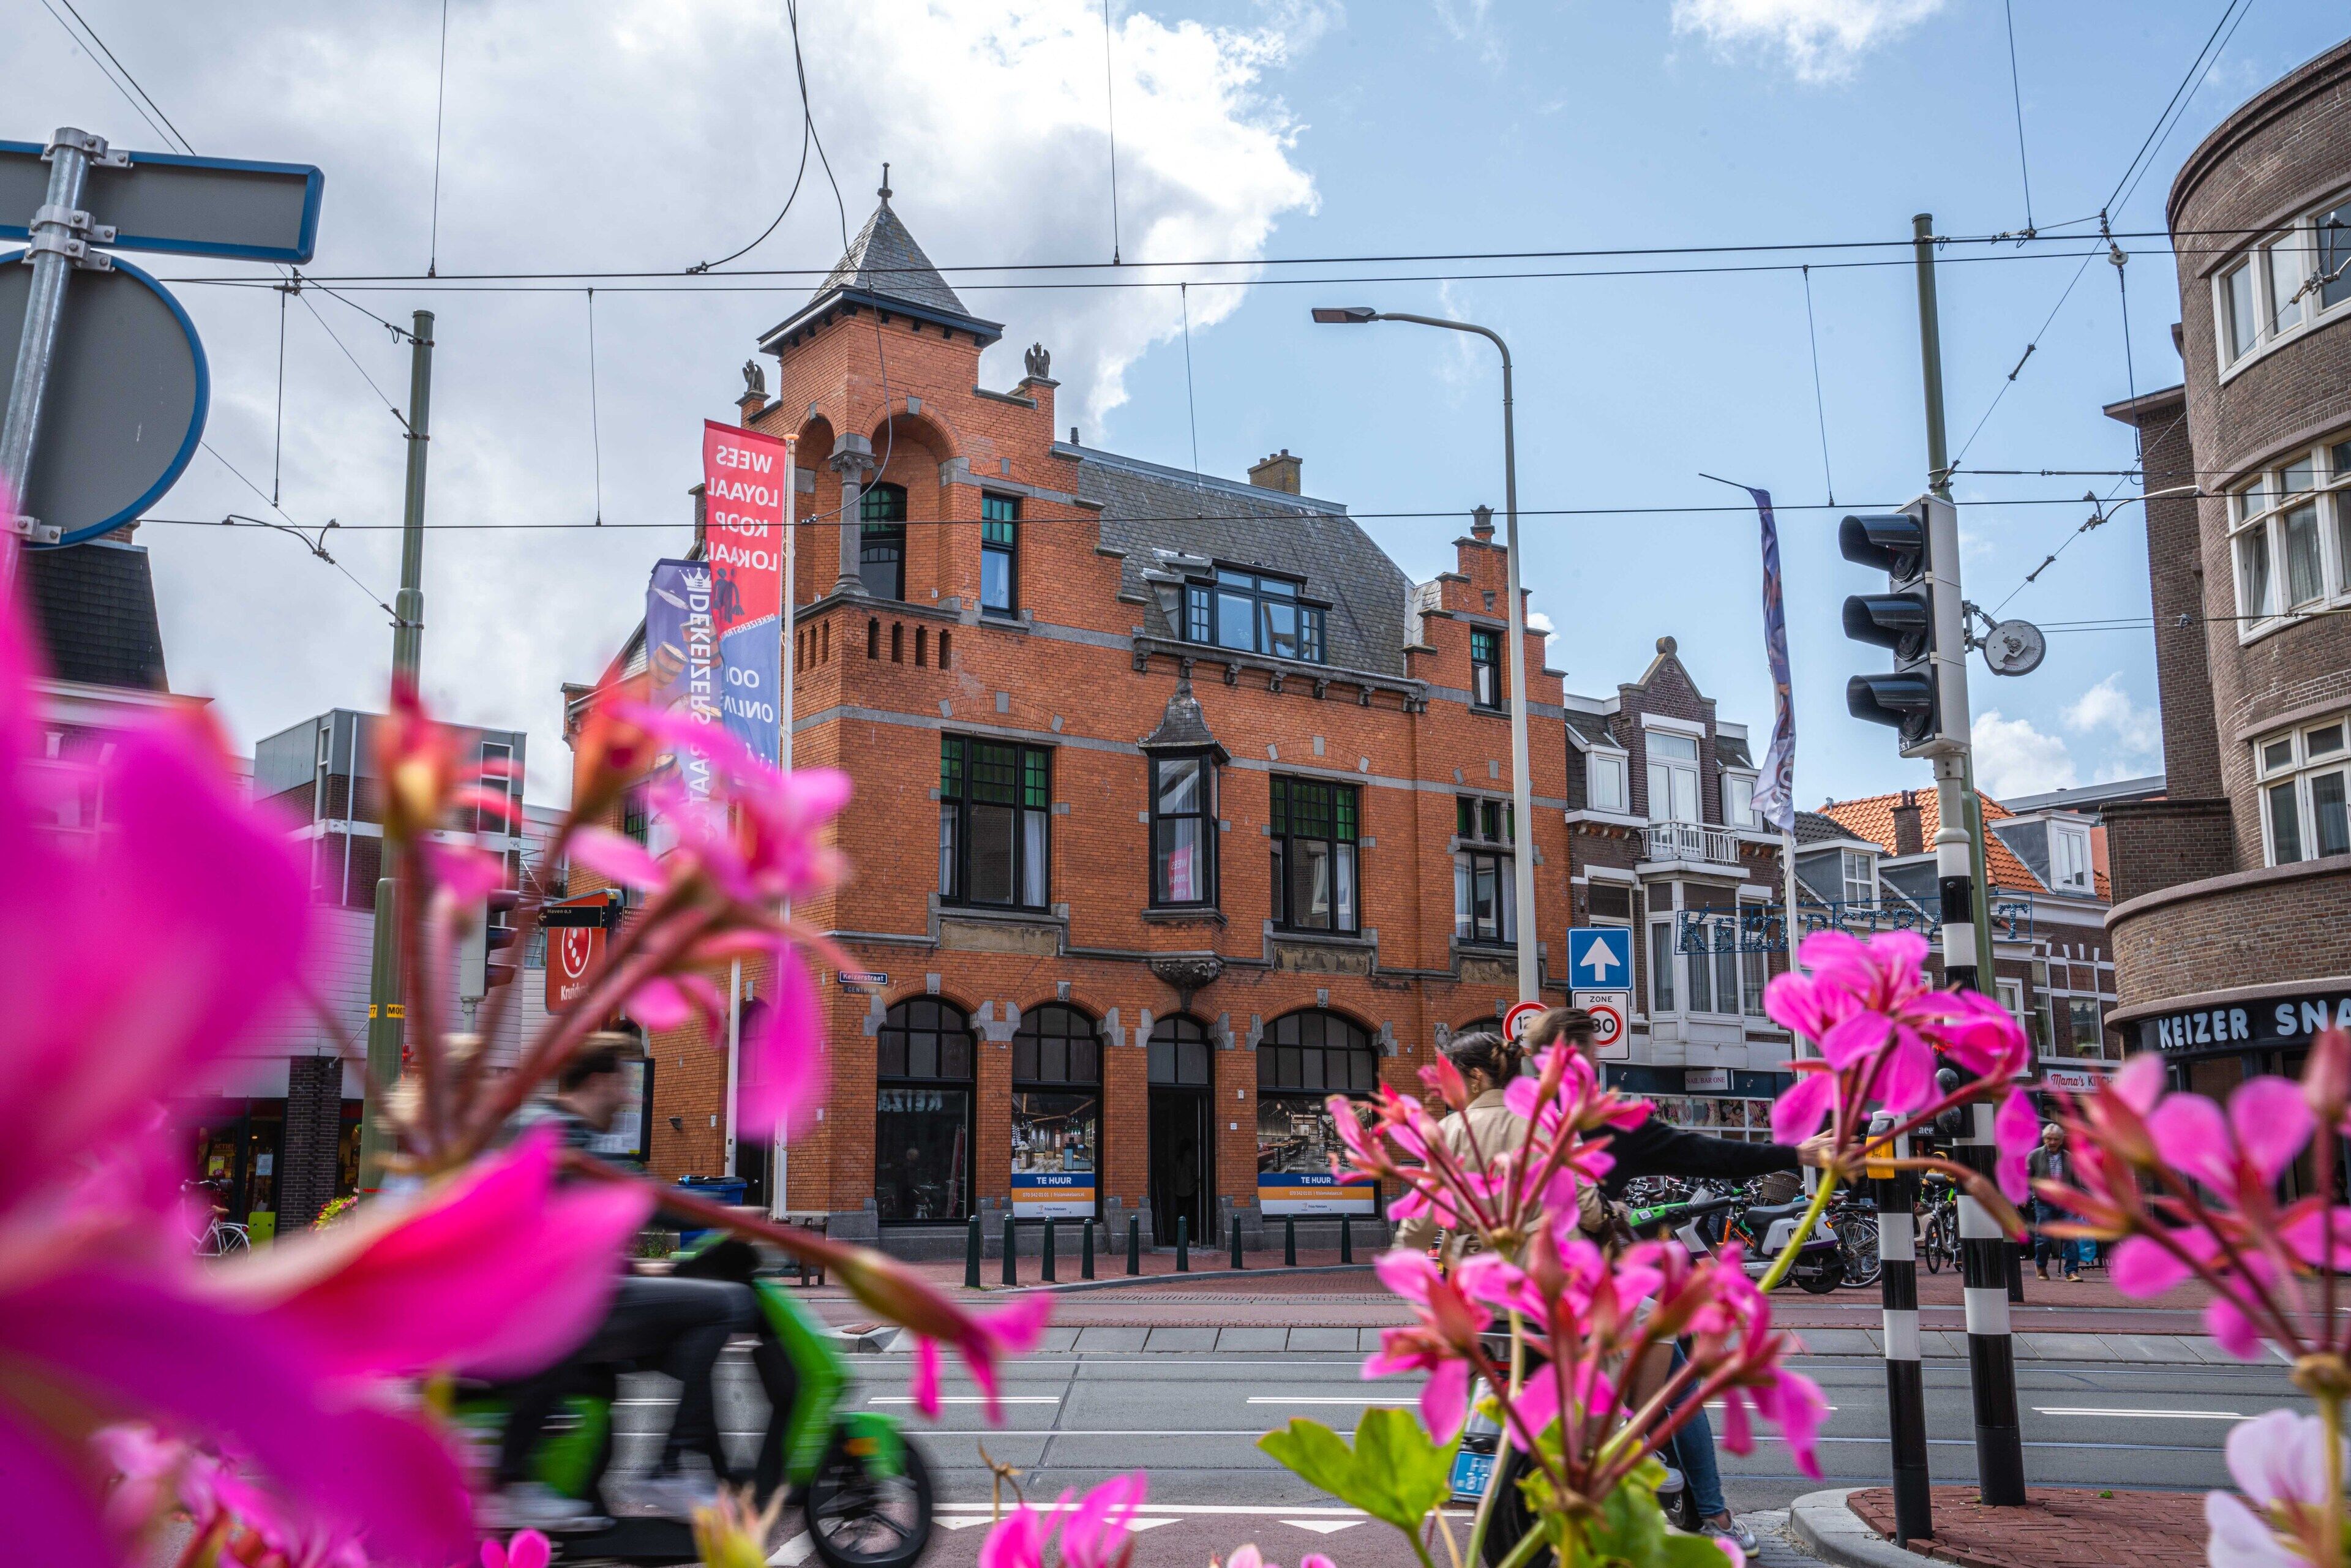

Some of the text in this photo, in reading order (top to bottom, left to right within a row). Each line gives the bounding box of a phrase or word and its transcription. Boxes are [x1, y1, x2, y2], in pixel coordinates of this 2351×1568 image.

[843, 973, 884, 981] Keizerstraat
[1591, 1018, 1615, 1033] 30
[2158, 1008, 2249, 1049] KEIZER
[2050, 1073, 2085, 1088] Mama's
